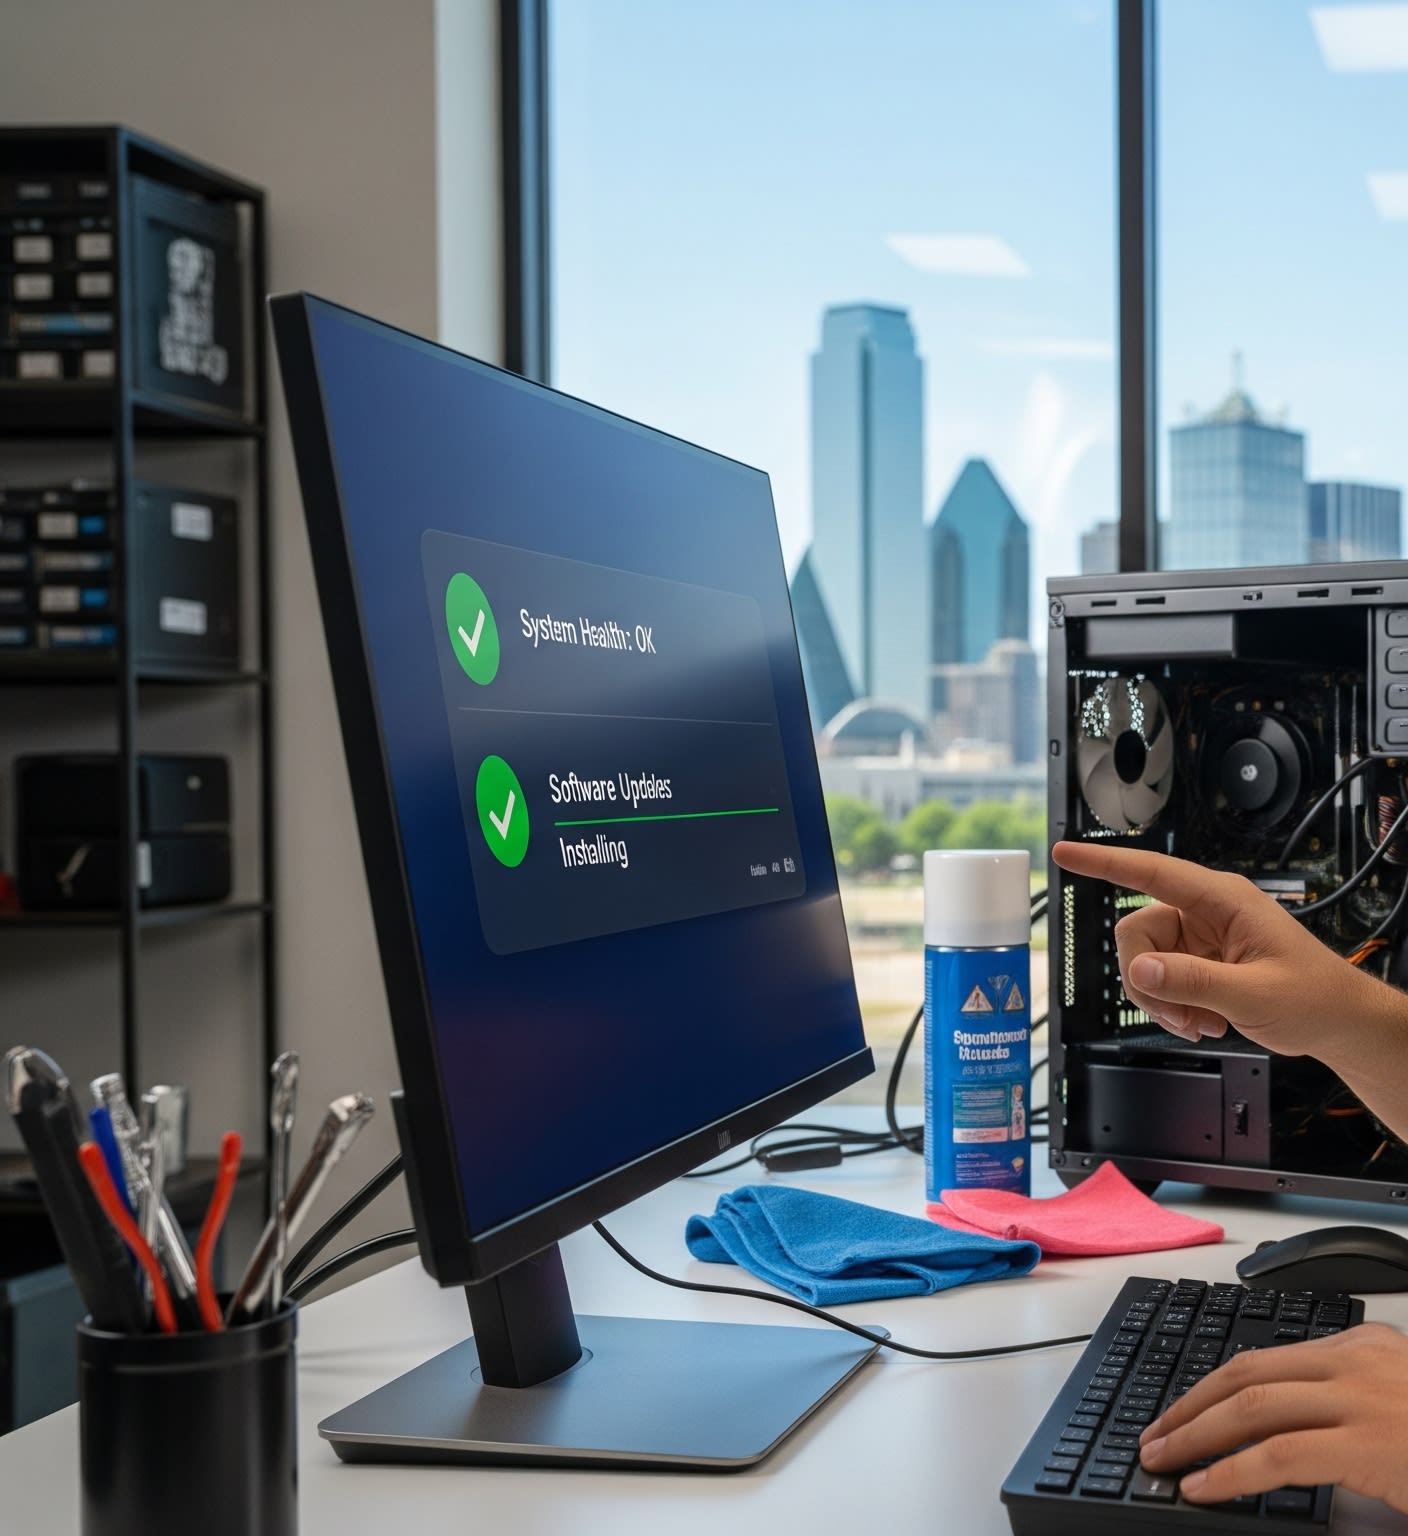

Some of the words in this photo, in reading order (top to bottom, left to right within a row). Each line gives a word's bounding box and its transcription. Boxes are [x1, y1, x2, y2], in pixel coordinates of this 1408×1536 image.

[520, 608, 578, 648] System
[635, 625, 657, 654] OK
[549, 771, 617, 803] Software
[559, 834, 629, 869] Installing
